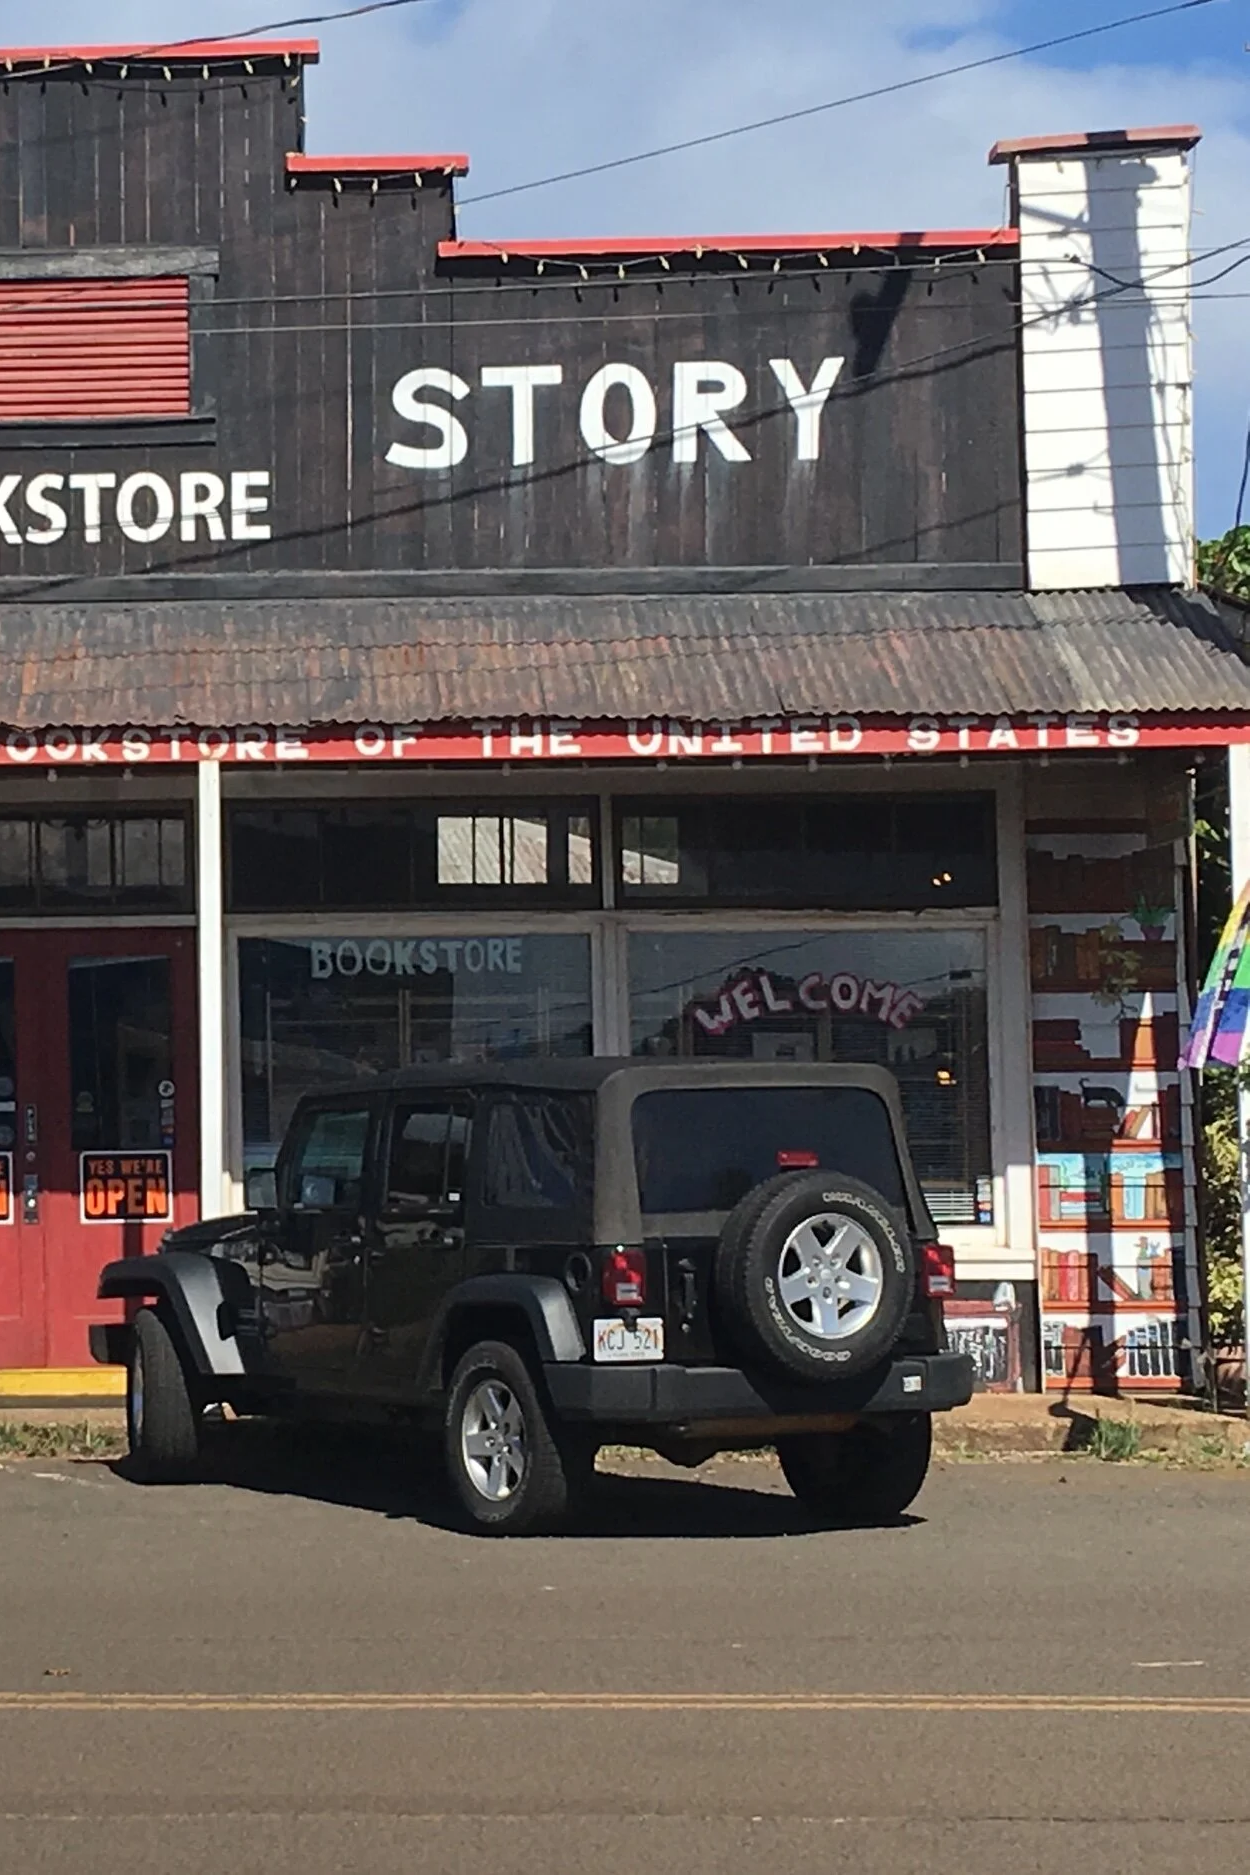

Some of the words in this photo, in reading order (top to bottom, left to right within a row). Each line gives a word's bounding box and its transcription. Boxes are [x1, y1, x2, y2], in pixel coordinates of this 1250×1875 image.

[384, 356, 845, 469] STORY
[354, 723, 424, 758] OF
[472, 719, 583, 757] THE
[628, 716, 863, 754] UNITED
[906, 714, 1142, 751] STATES
[310, 938, 523, 979] BOOKSTORE
[693, 971, 925, 1036] WELCOME
[89, 1160, 114, 1175] YES
[86, 1178, 167, 1215] OPEN
